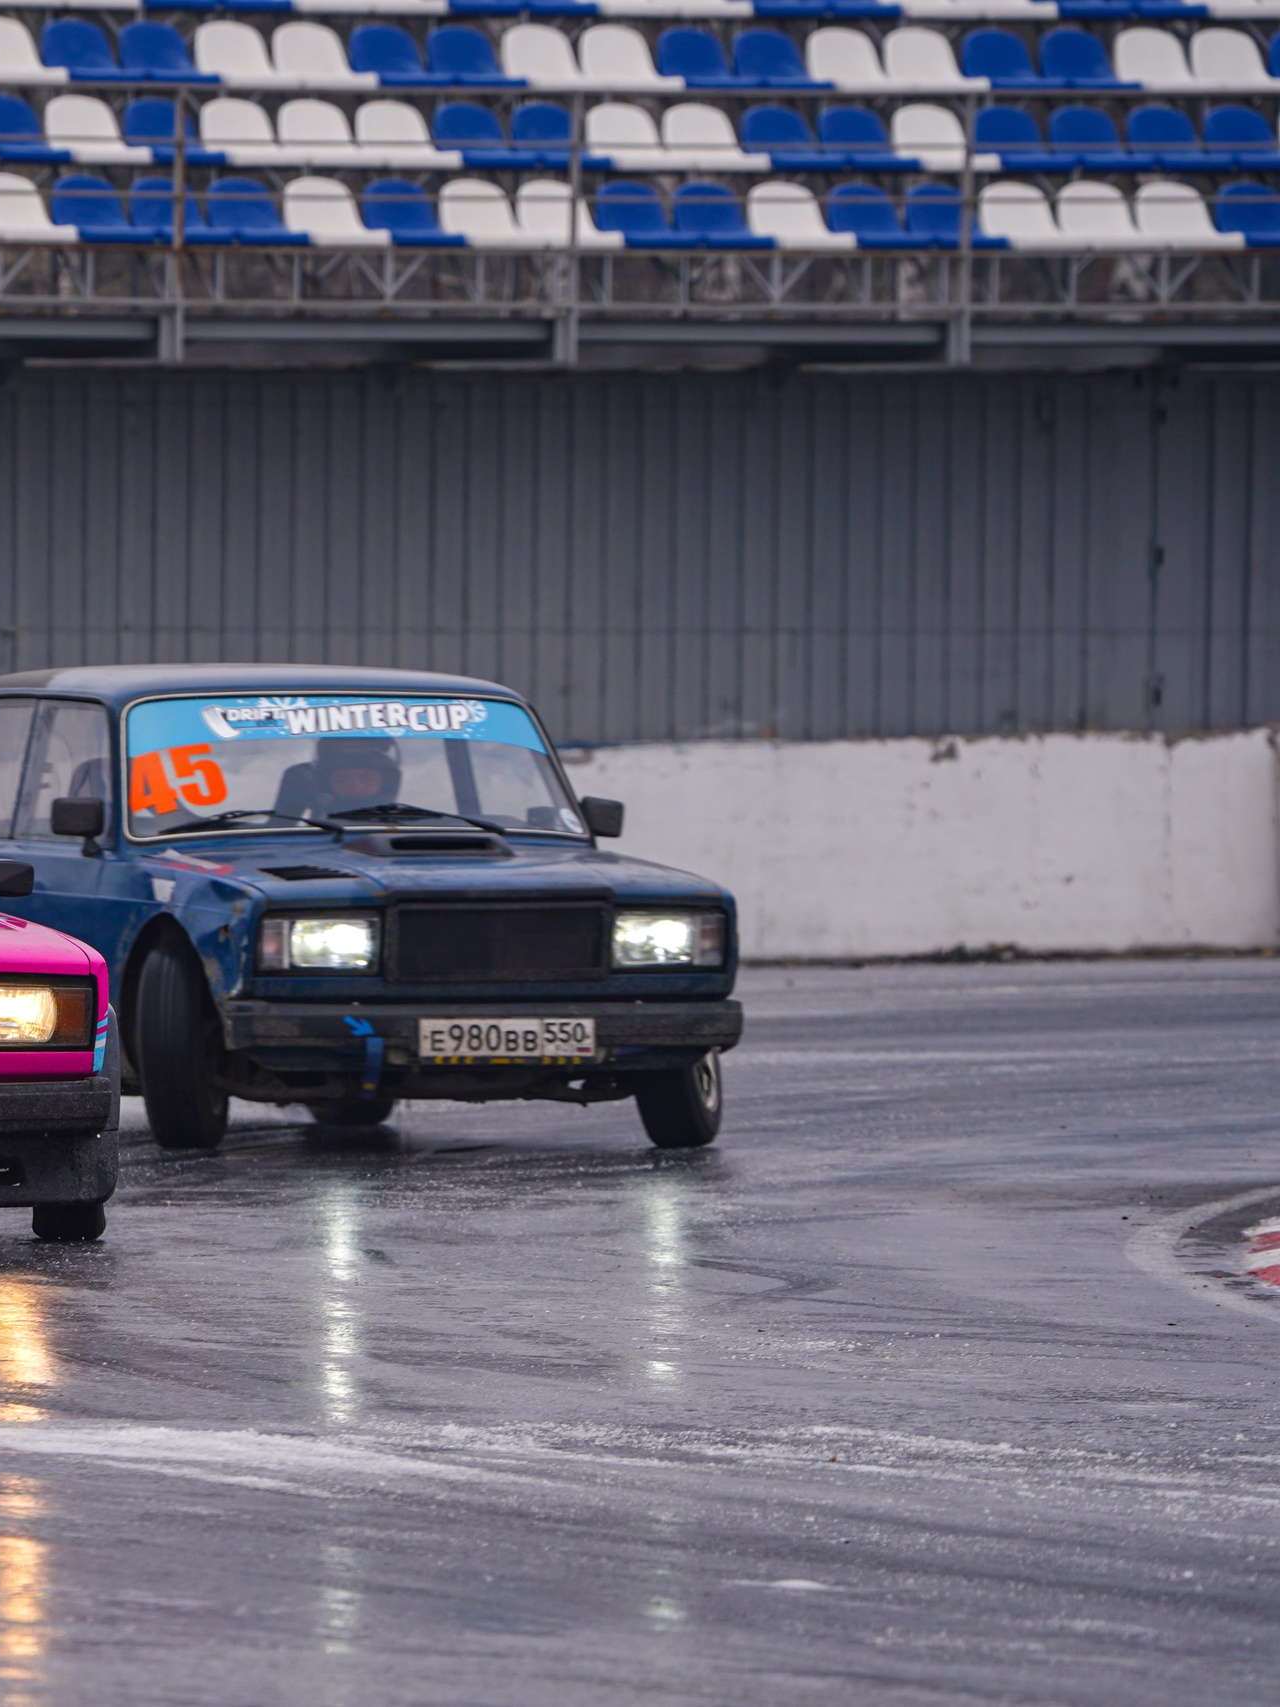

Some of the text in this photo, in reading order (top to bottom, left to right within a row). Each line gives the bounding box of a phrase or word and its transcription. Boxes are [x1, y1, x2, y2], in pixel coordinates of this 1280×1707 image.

[226, 707, 283, 721] DRIFT
[129, 743, 229, 815] 45
[544, 1022, 586, 1044] 550
